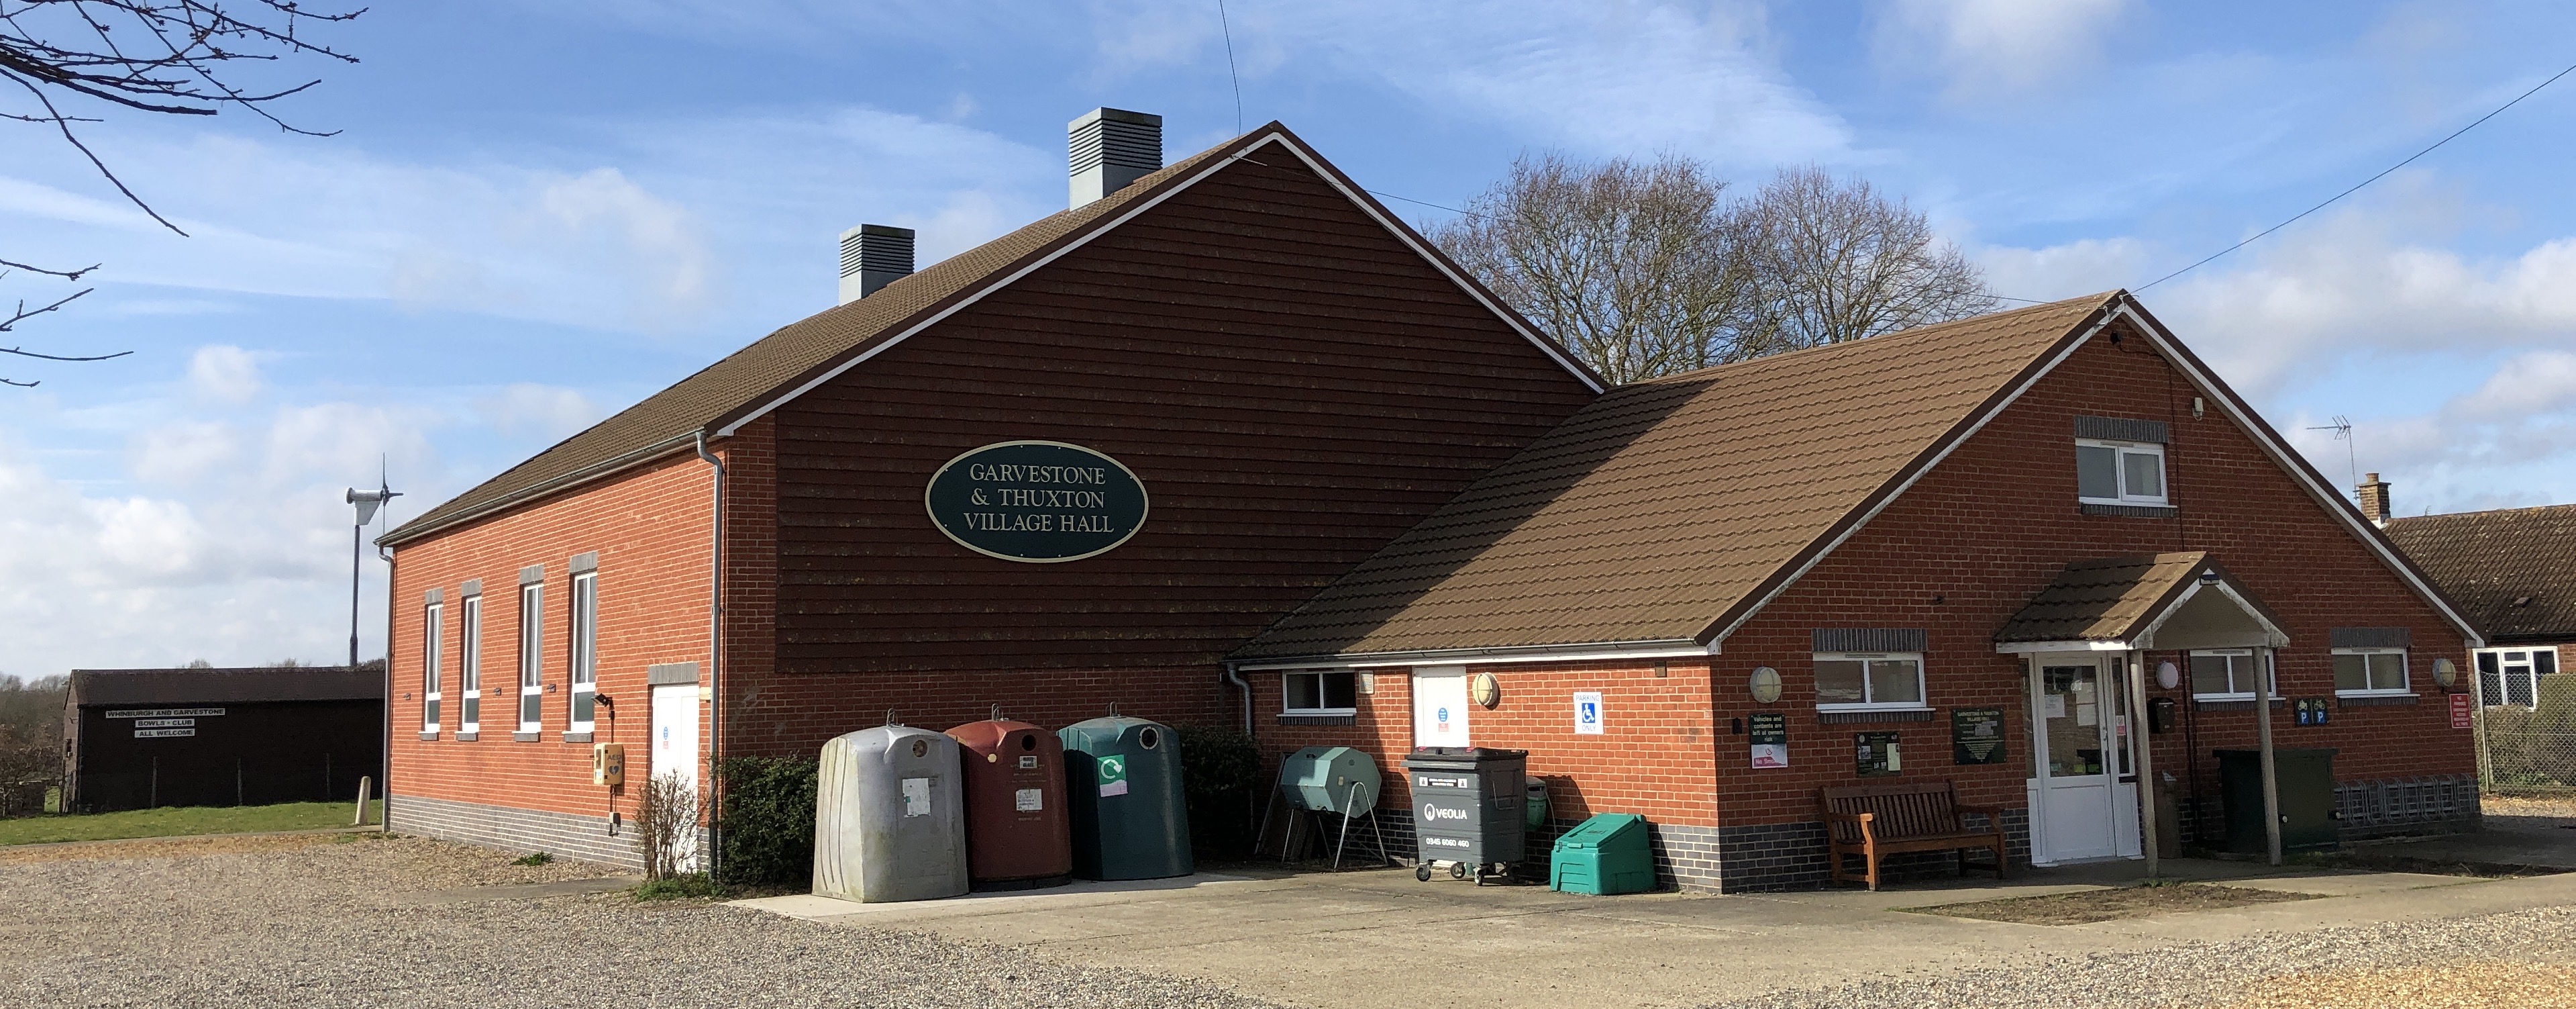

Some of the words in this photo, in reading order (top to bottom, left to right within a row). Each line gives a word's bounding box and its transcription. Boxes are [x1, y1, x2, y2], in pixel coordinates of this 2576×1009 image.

[970, 463, 1106, 485] GARVESTONE
[971, 487, 990, 506] &
[998, 489, 1104, 508] THUXTON
[964, 512, 1052, 532] VILLAGE
[1060, 514, 1115, 533] HALL
[2302, 712, 2307, 723] P
[2318, 712, 2323, 722] P
[1436, 808, 1467, 820] VEOLIA
[1426, 837, 1441, 845] 0345
[1441, 838, 1457, 847] 6060
